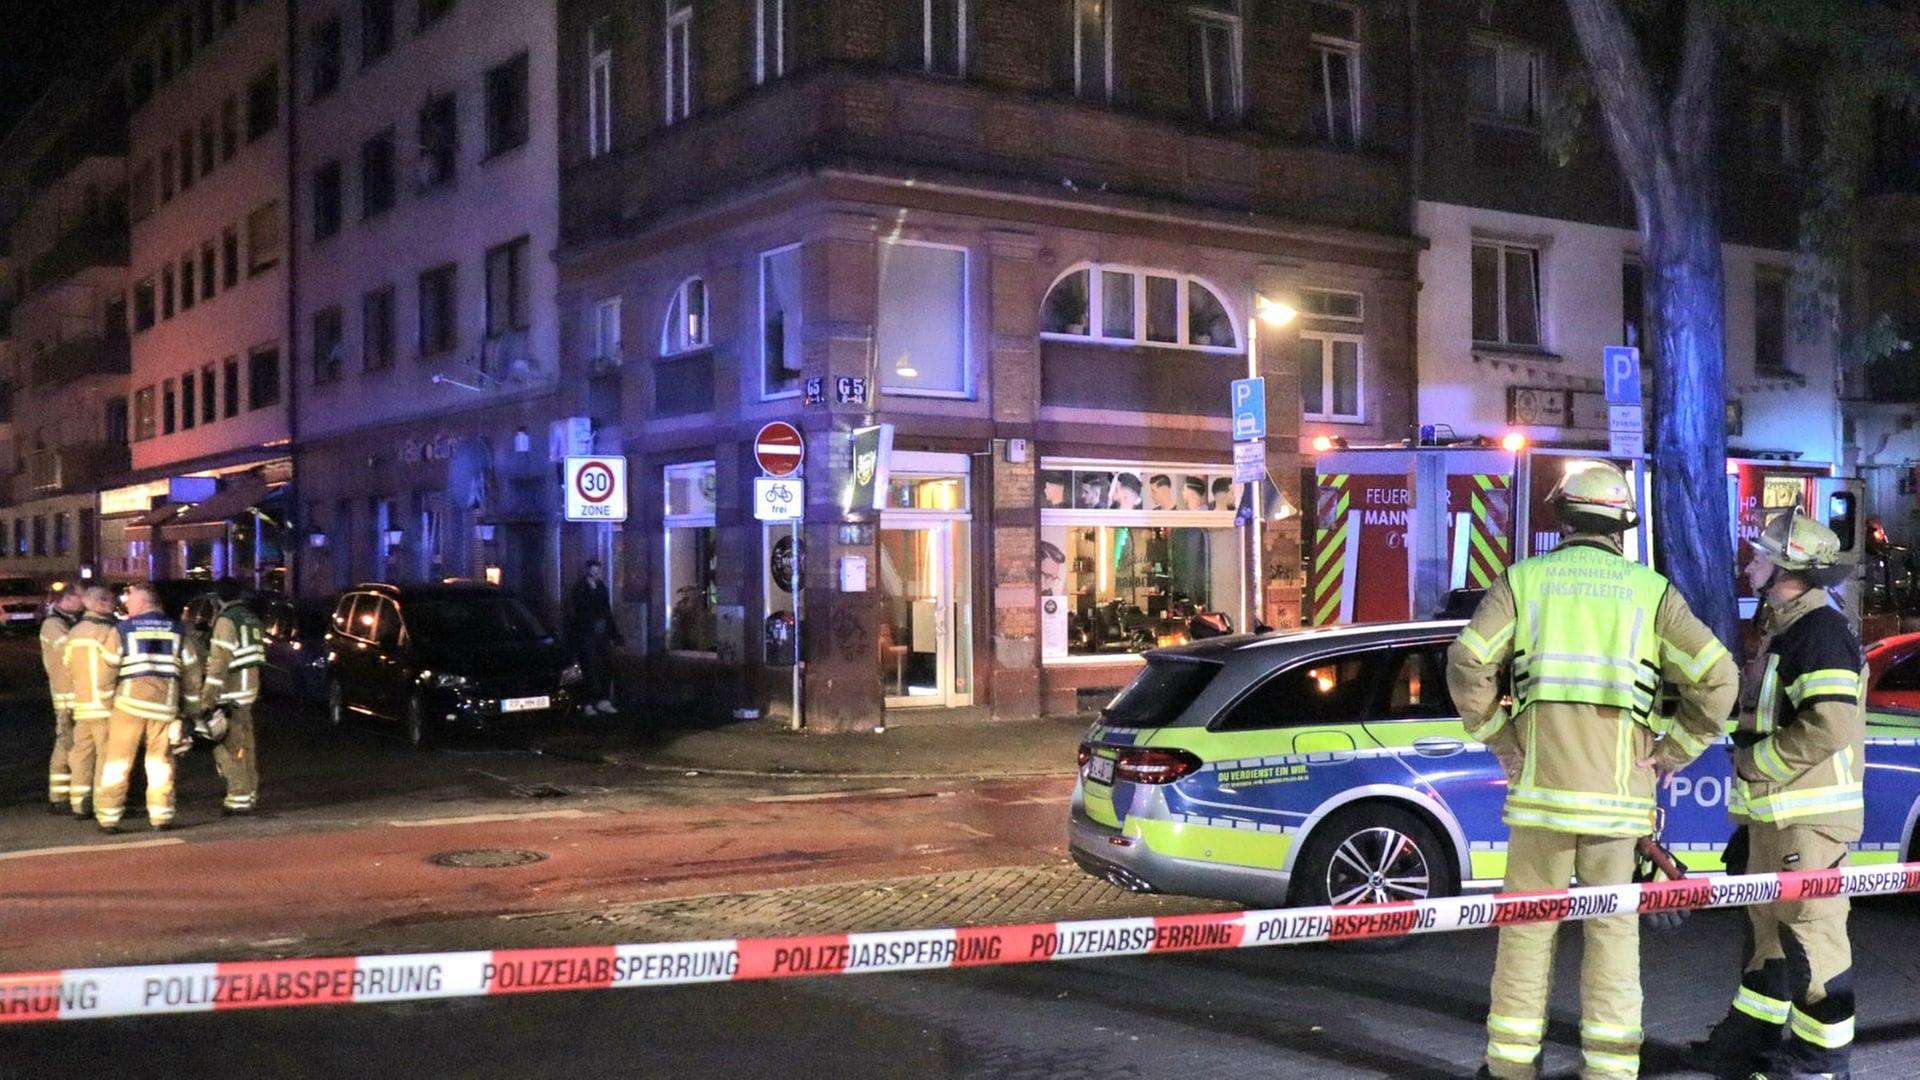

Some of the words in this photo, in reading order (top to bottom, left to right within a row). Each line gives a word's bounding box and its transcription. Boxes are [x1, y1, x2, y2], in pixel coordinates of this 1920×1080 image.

[1613, 354, 1632, 394] P
[1237, 383, 1251, 407] P
[584, 473, 607, 491] 30
[581, 505, 611, 516] ZONE
[771, 504, 788, 514] frei
[1545, 566, 1624, 580] MANNHEIM
[1218, 772, 1230, 782] DU
[1231, 768, 1273, 780] VERDIENST
[1275, 766, 1288, 776] EIN
[145, 966, 442, 1007] POLIZEIABSPERRUNG
[482, 949, 740, 989] POLIZEIABSPERRUNG
[773, 936, 1002, 974] POLIZEIABSPERRUNG
[1030, 924, 1232, 957] POLIZEIABSPERRUNG
[1257, 907, 1436, 940] POLIZEIABSPERRUNG
[1458, 892, 1617, 925] POLIZEIABSPERRUNG
[1637, 880, 1782, 911] POLIZEIABSPERRUNG
